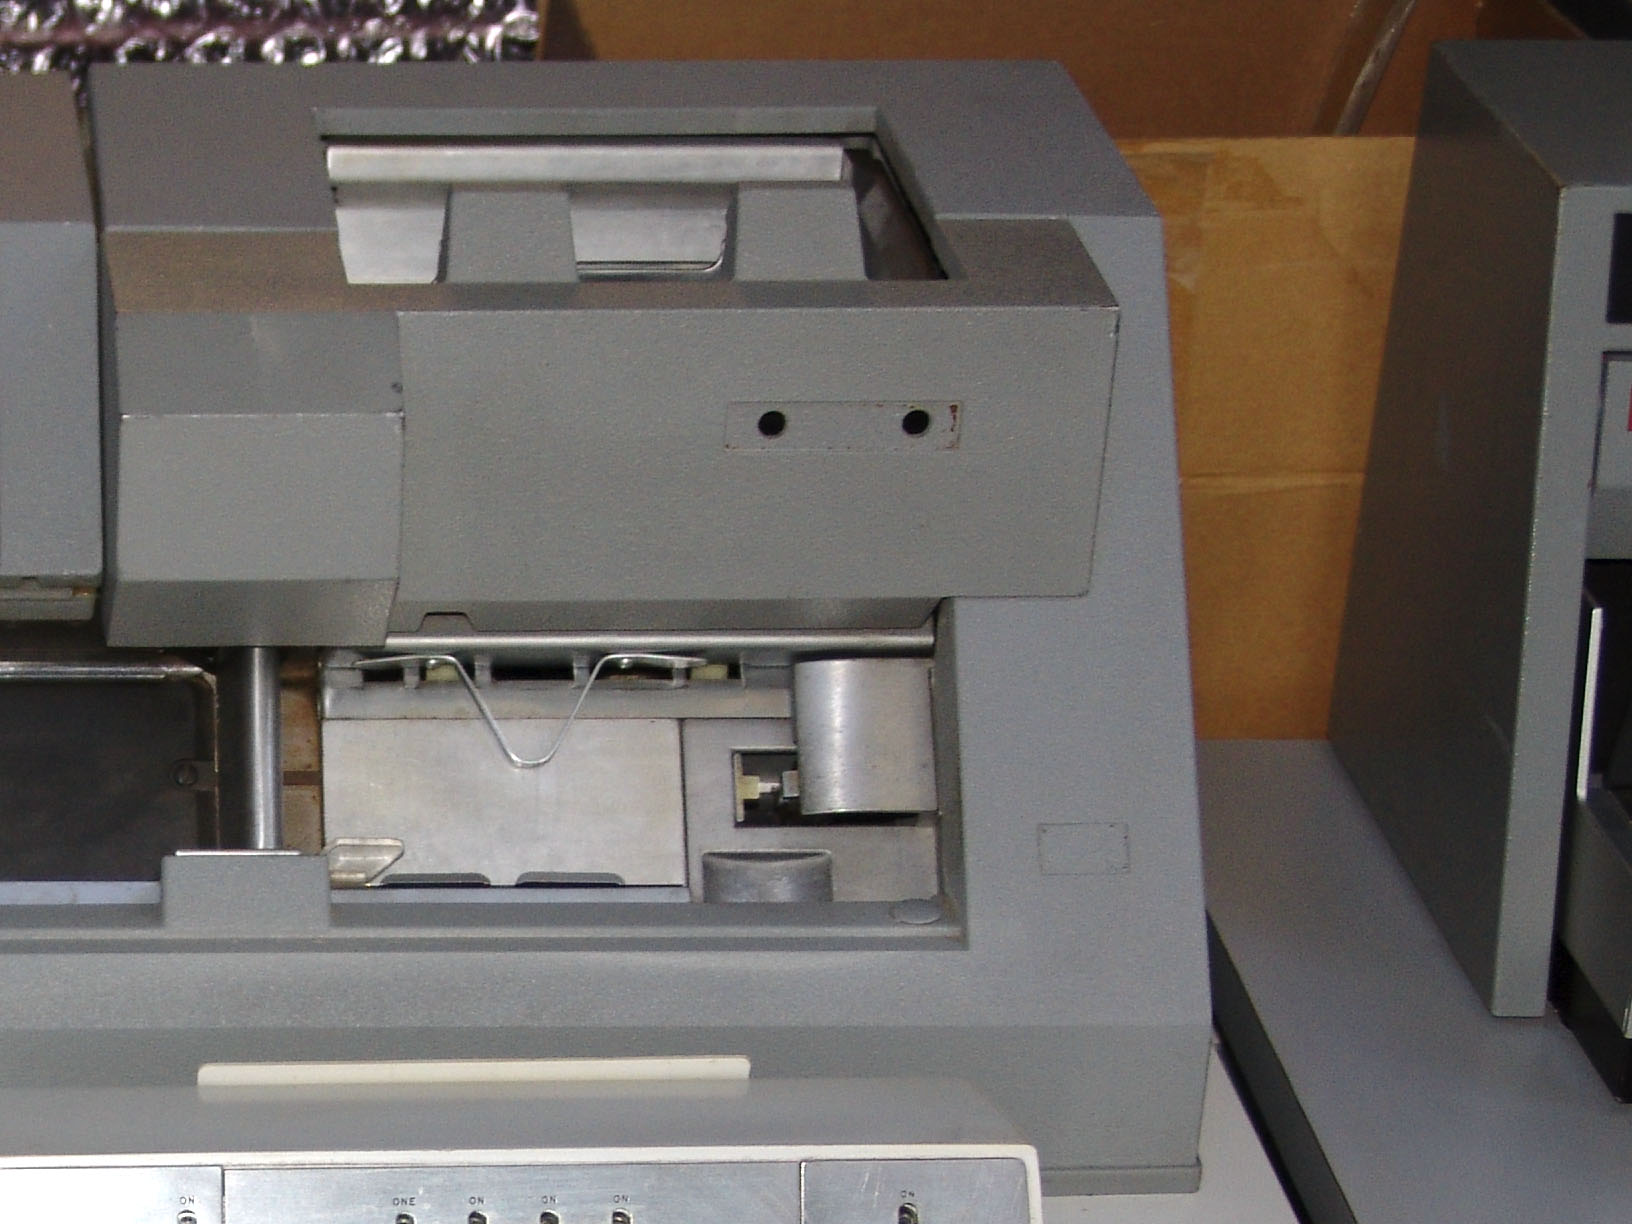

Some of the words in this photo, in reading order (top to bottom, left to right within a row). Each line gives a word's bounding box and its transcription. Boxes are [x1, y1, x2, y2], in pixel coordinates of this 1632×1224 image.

[179, 1196, 195, 1205] ON
[392, 1197, 416, 1206] ONE
[469, 1196, 485, 1205] ON
[541, 1196, 557, 1204] ON
[613, 1195, 630, 1203] ON
